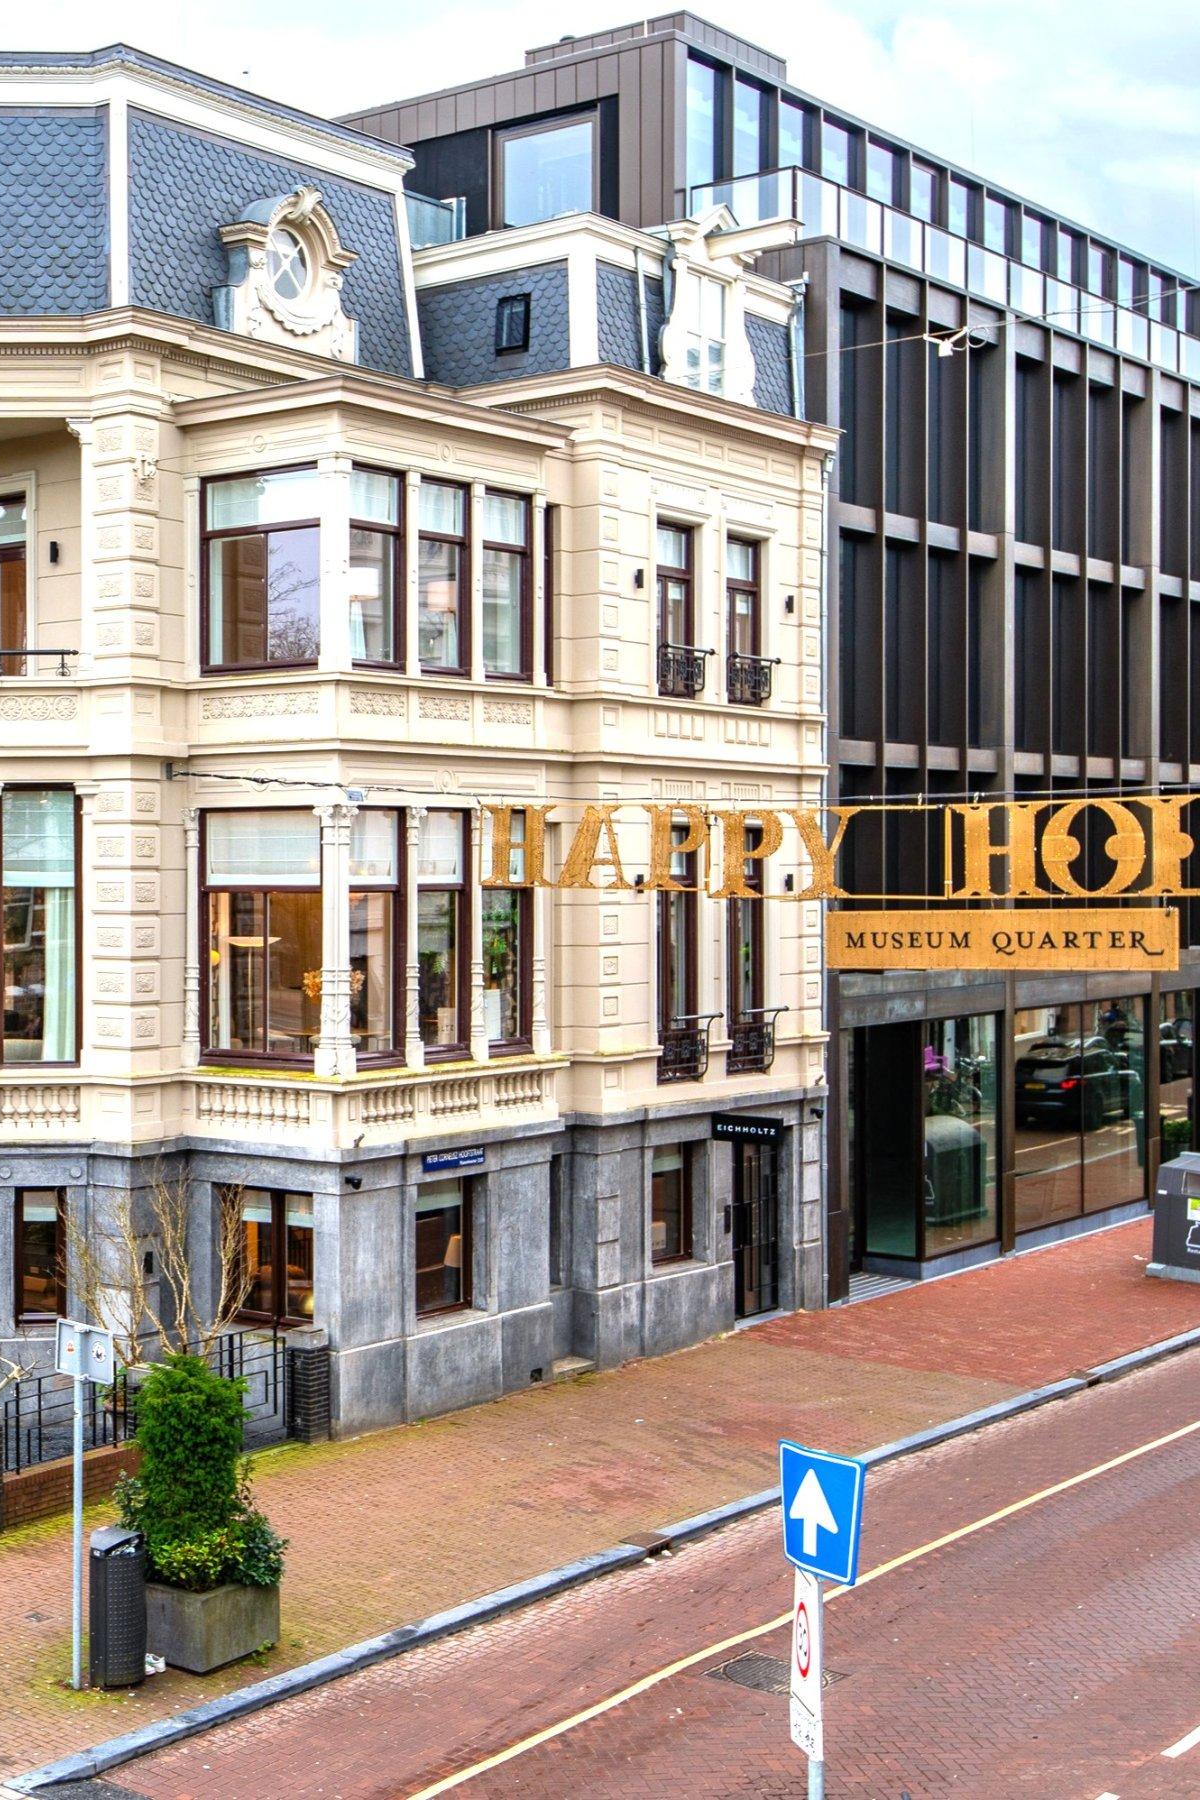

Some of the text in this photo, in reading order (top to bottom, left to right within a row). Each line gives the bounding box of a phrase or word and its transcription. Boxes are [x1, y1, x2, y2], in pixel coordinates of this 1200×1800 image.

[481, 804, 863, 898] HAPPY
[845, 931, 1165, 956] MUSEUM QUARTER
[716, 1123, 776, 1136] EICHHOLTZ
